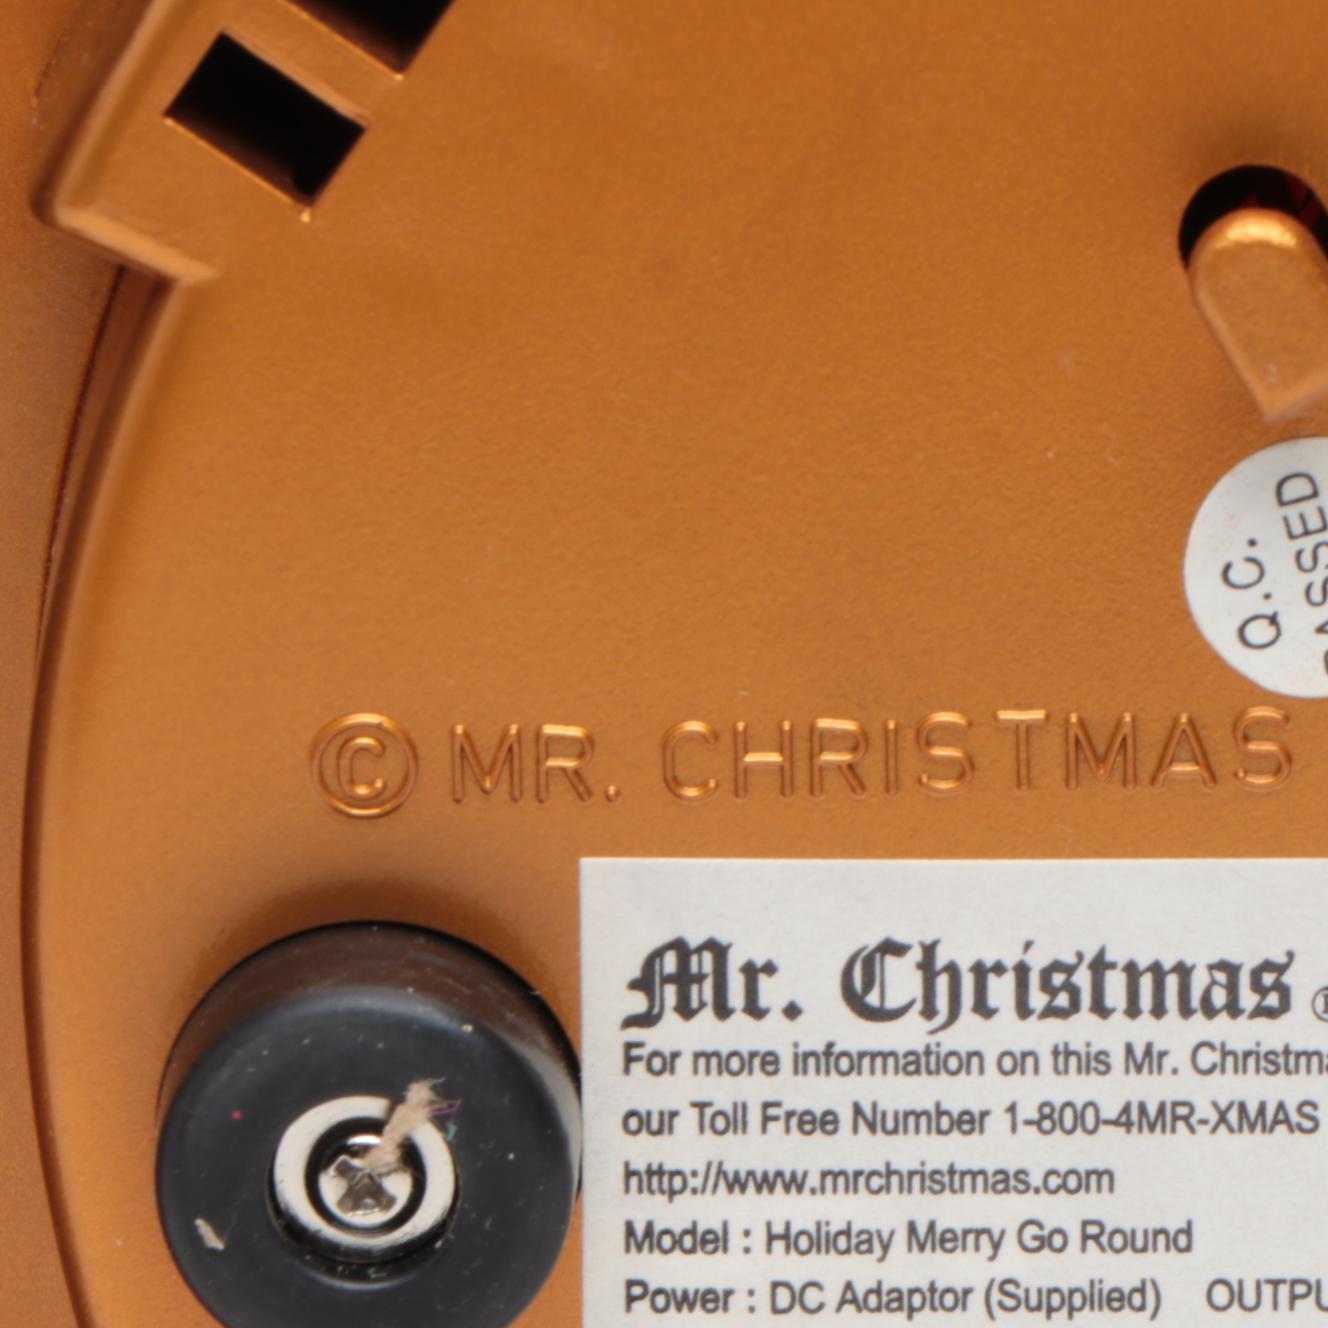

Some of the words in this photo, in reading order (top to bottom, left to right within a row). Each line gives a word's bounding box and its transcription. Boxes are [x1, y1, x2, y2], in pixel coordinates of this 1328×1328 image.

[1221, 537, 1283, 650] Q.C.
[449, 722, 620, 804] MR.
[662, 705, 1296, 802] CHRISTMAS
[621, 937, 802, 1031] Mr.
[841, 938, 1294, 1035] Christmas
[624, 1041, 681, 1076] For
[693, 1050, 780, 1076] more
[794, 1042, 984, 1076] information
[997, 1051, 1039, 1076] on
[1052, 1043, 1111, 1075] this
[1125, 1042, 1177, 1074] Mr.
[622, 1109, 679, 1136] our
[690, 1102, 747, 1136] Toll
[762, 1101, 839, 1135] Free
[853, 1102, 990, 1135] Number
[1005, 1101, 1319, 1135] 1-800-4MR-XMAS
[624, 1161, 1114, 1203] http://www.mrchristmas.com
[625, 1220, 728, 1254] Model
[767, 1221, 894, 1262] Holiday
[908, 1220, 1005, 1261] Merry
[1018, 1219, 1068, 1253] Go
[1081, 1220, 1192, 1253] Round
[626, 1279, 734, 1313] Power
[771, 1281, 825, 1314] DC
[836, 1281, 973, 1320] Adaptor
[985, 1279, 1160, 1320] (Supplied)
